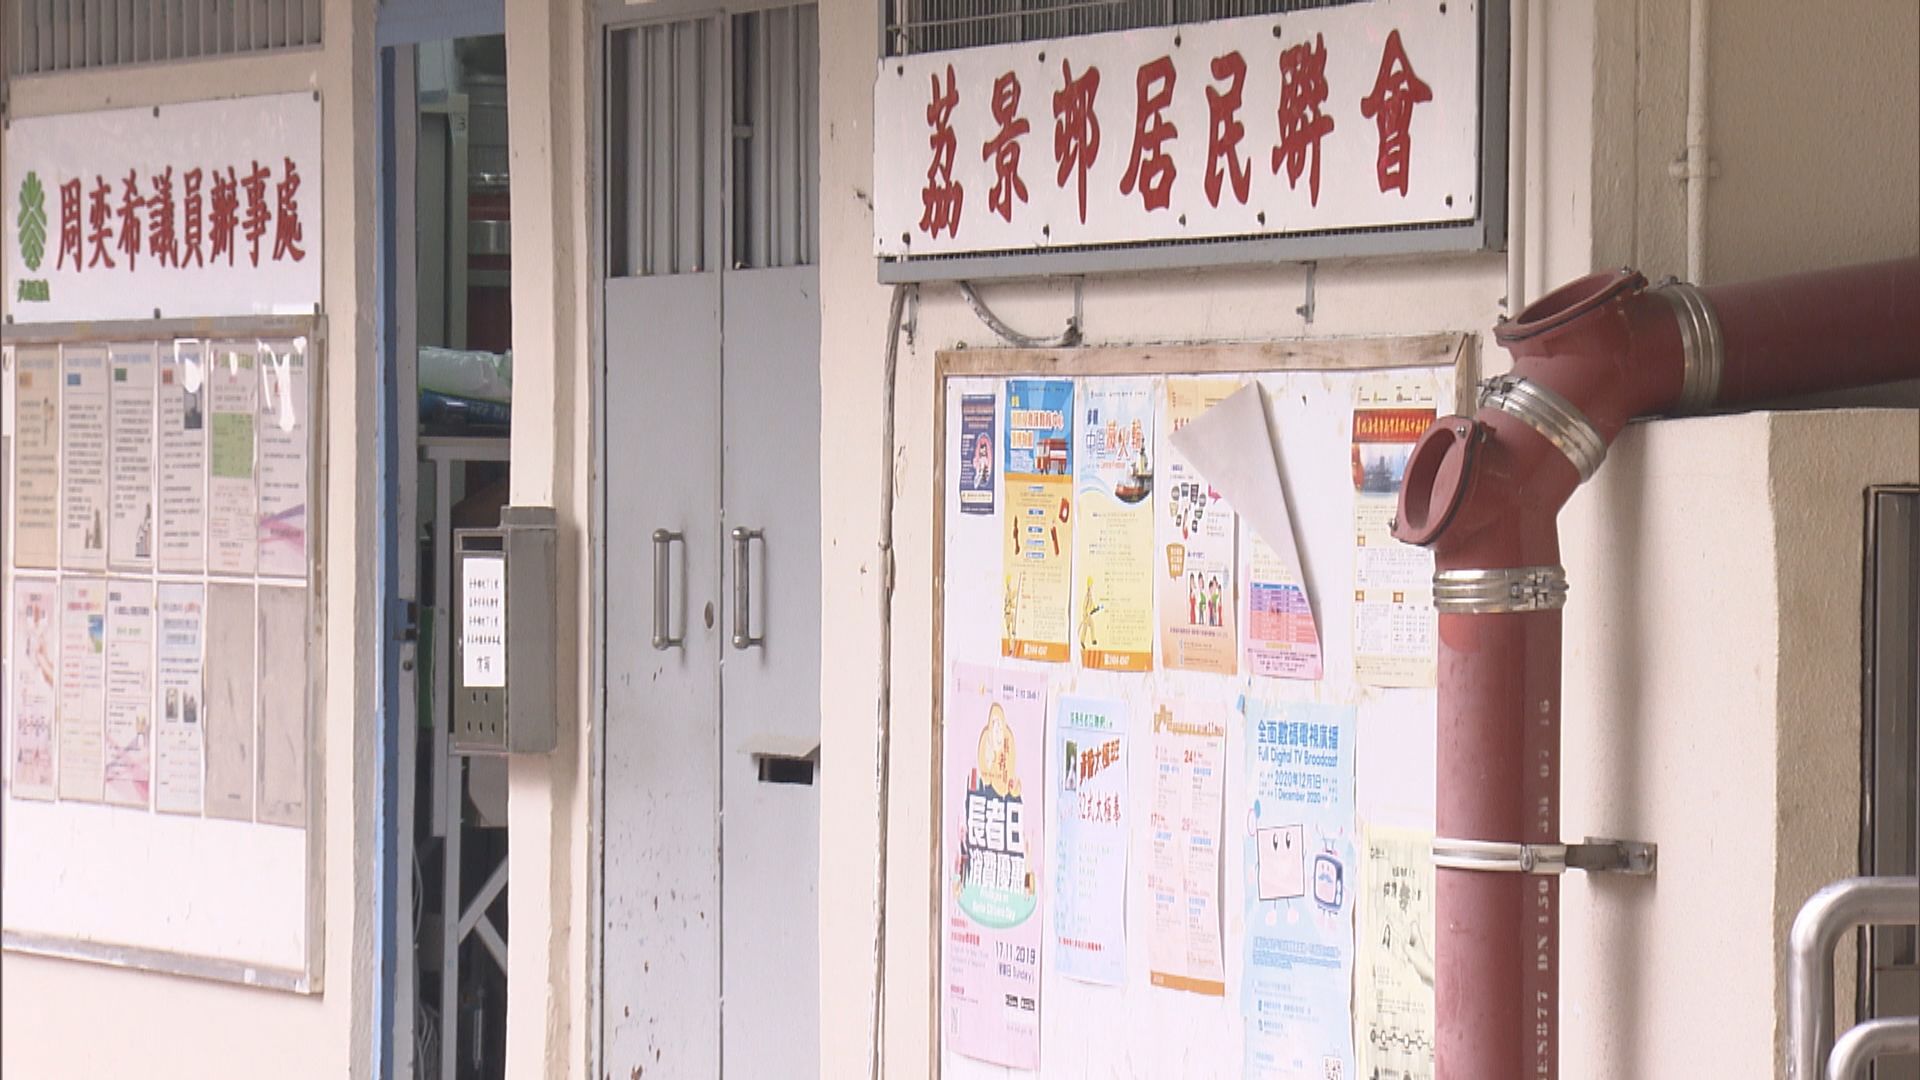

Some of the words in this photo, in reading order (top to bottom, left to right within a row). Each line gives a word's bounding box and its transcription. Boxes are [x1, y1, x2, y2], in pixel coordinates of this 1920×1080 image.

[918, 28, 1434, 241] 荔景邨居民聯會
[57, 156, 306, 272] 周奕希議員辦事處
[1258, 720, 1339, 750] 全面數碼電視廣播
[1258, 746, 1269, 762] Full
[1270, 748, 1293, 767] Digital
[1294, 749, 1303, 764] TV
[1304, 750, 1338, 767] Broadcast
[968, 794, 1024, 853] 長者日
[996, 941, 1036, 965] 17.11.2019
